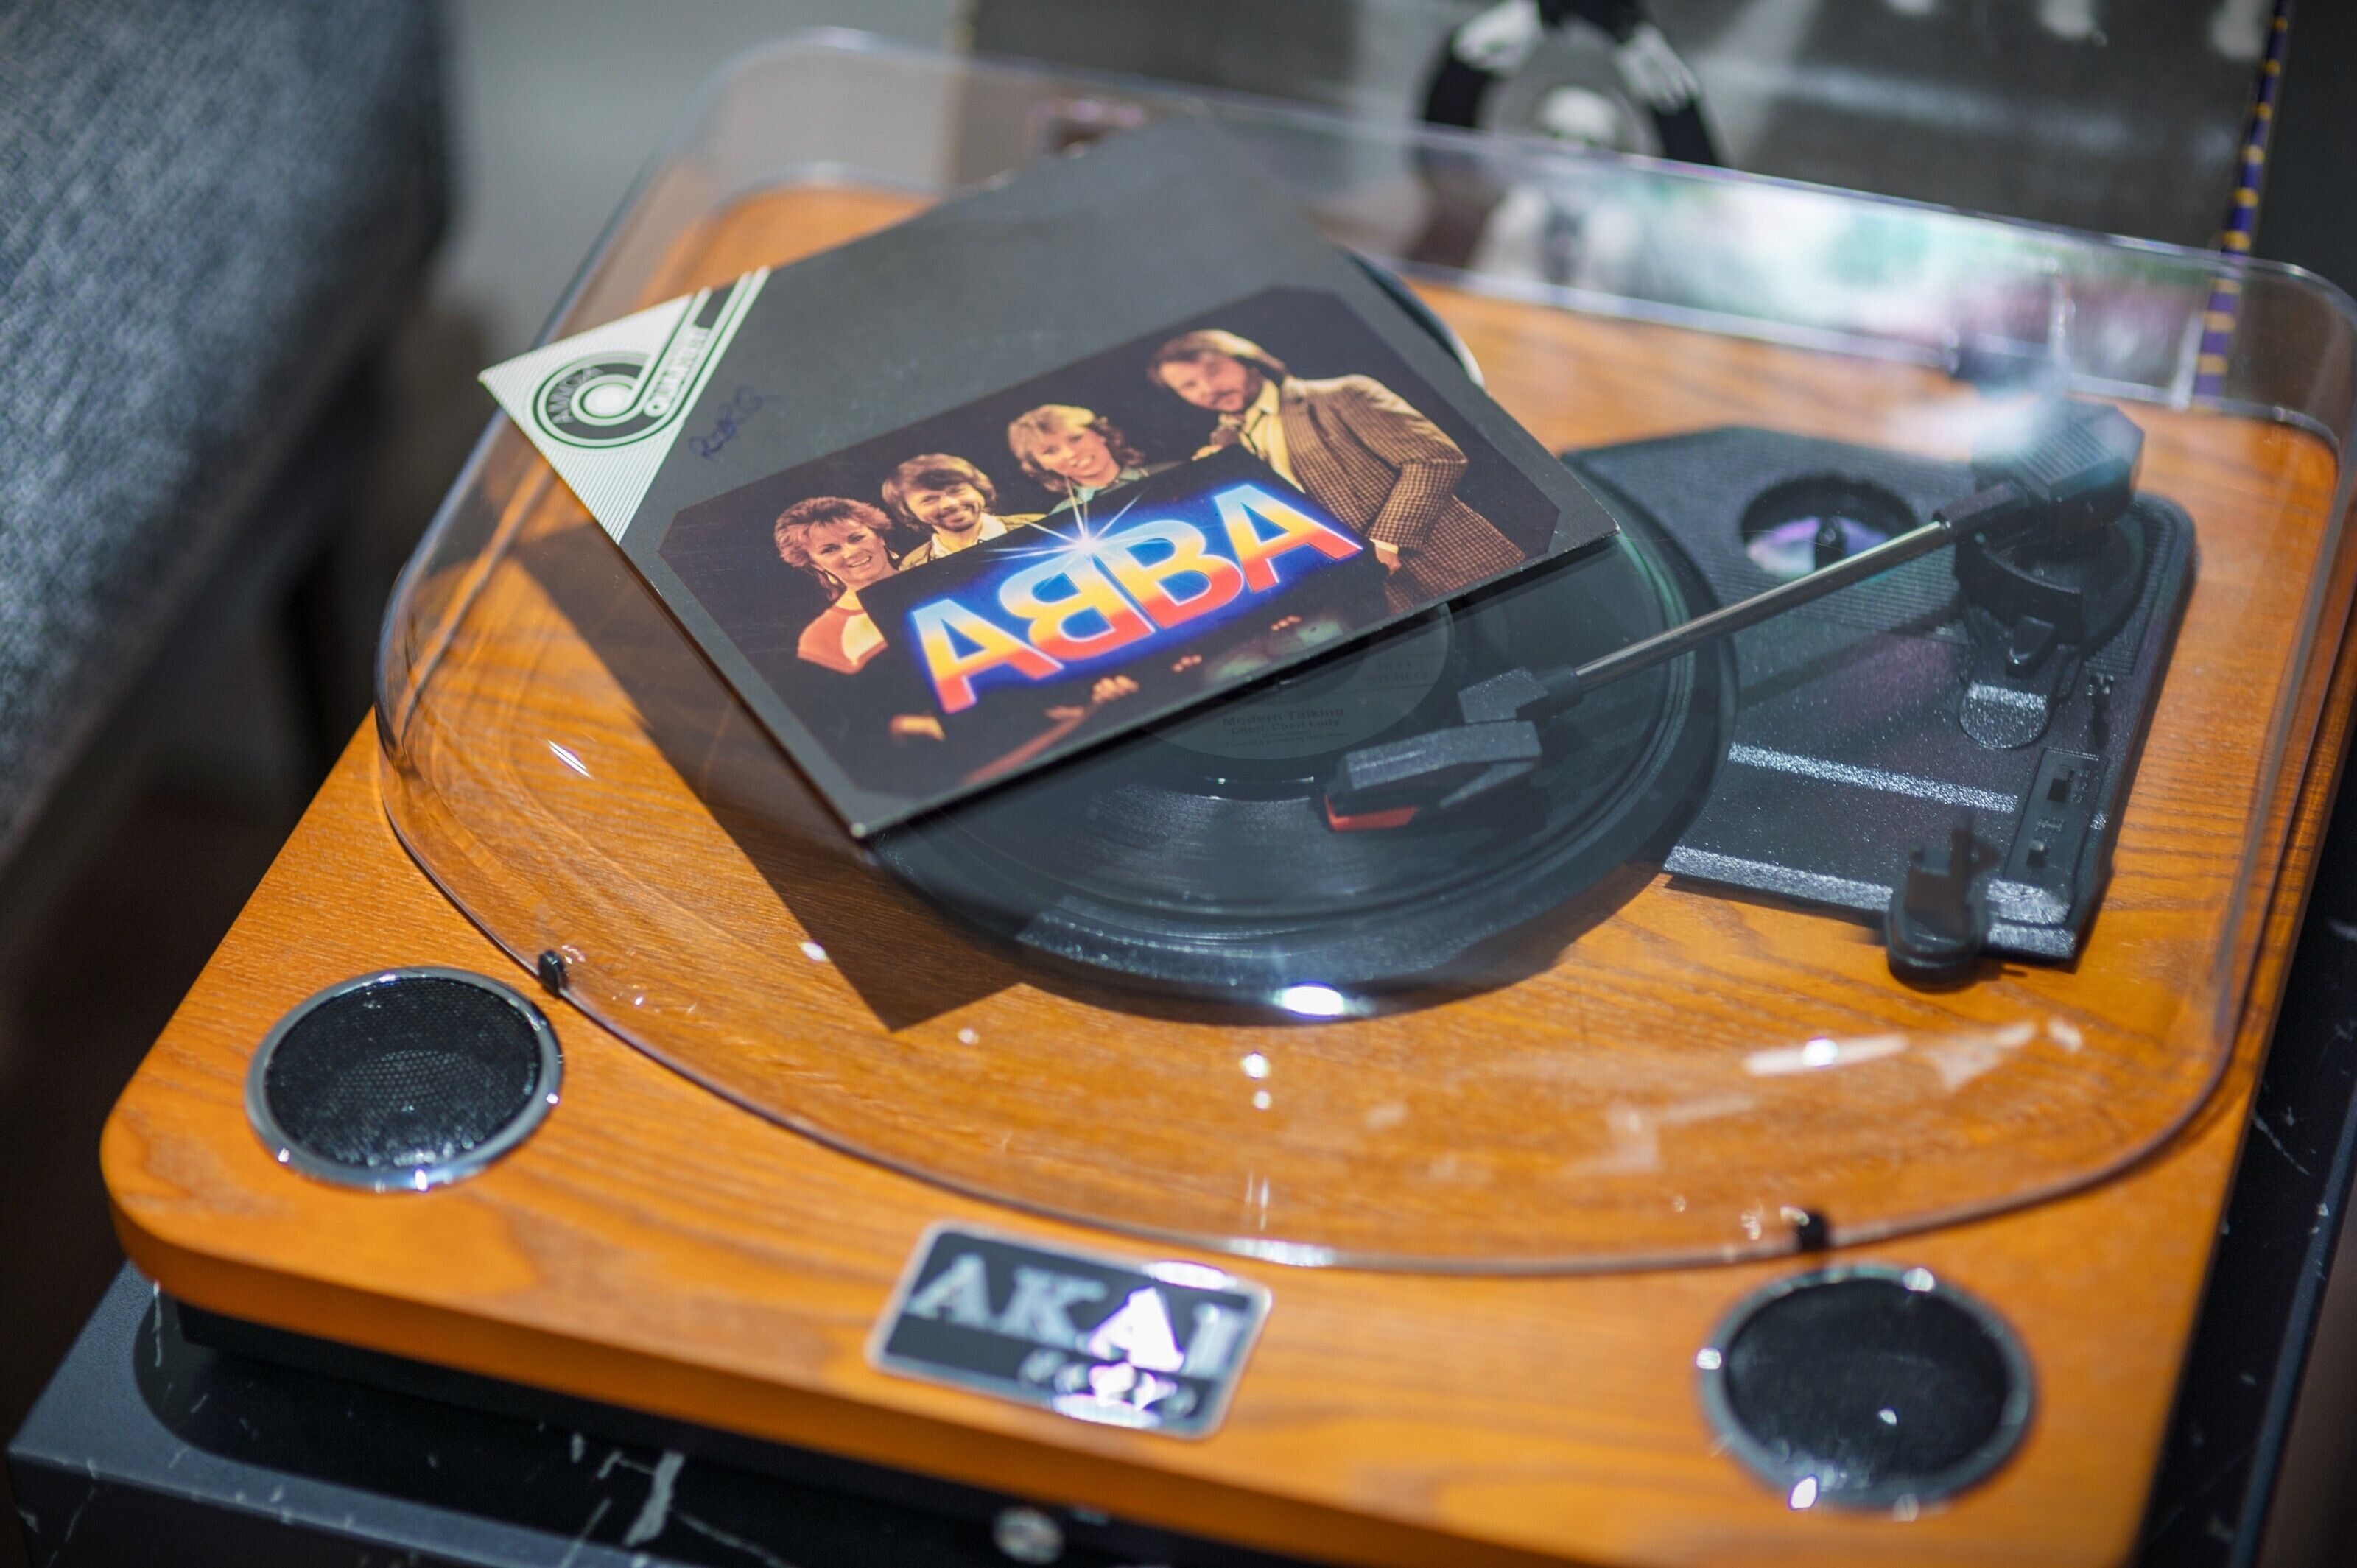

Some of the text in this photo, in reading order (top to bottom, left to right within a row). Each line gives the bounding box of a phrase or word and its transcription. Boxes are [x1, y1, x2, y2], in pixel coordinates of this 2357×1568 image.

[910, 483, 1363, 714] ABBA
[1222, 708, 1344, 727] Modern Talking
[1309, 718, 1339, 728] Lady
[903, 1252, 1245, 1380] AKAI
